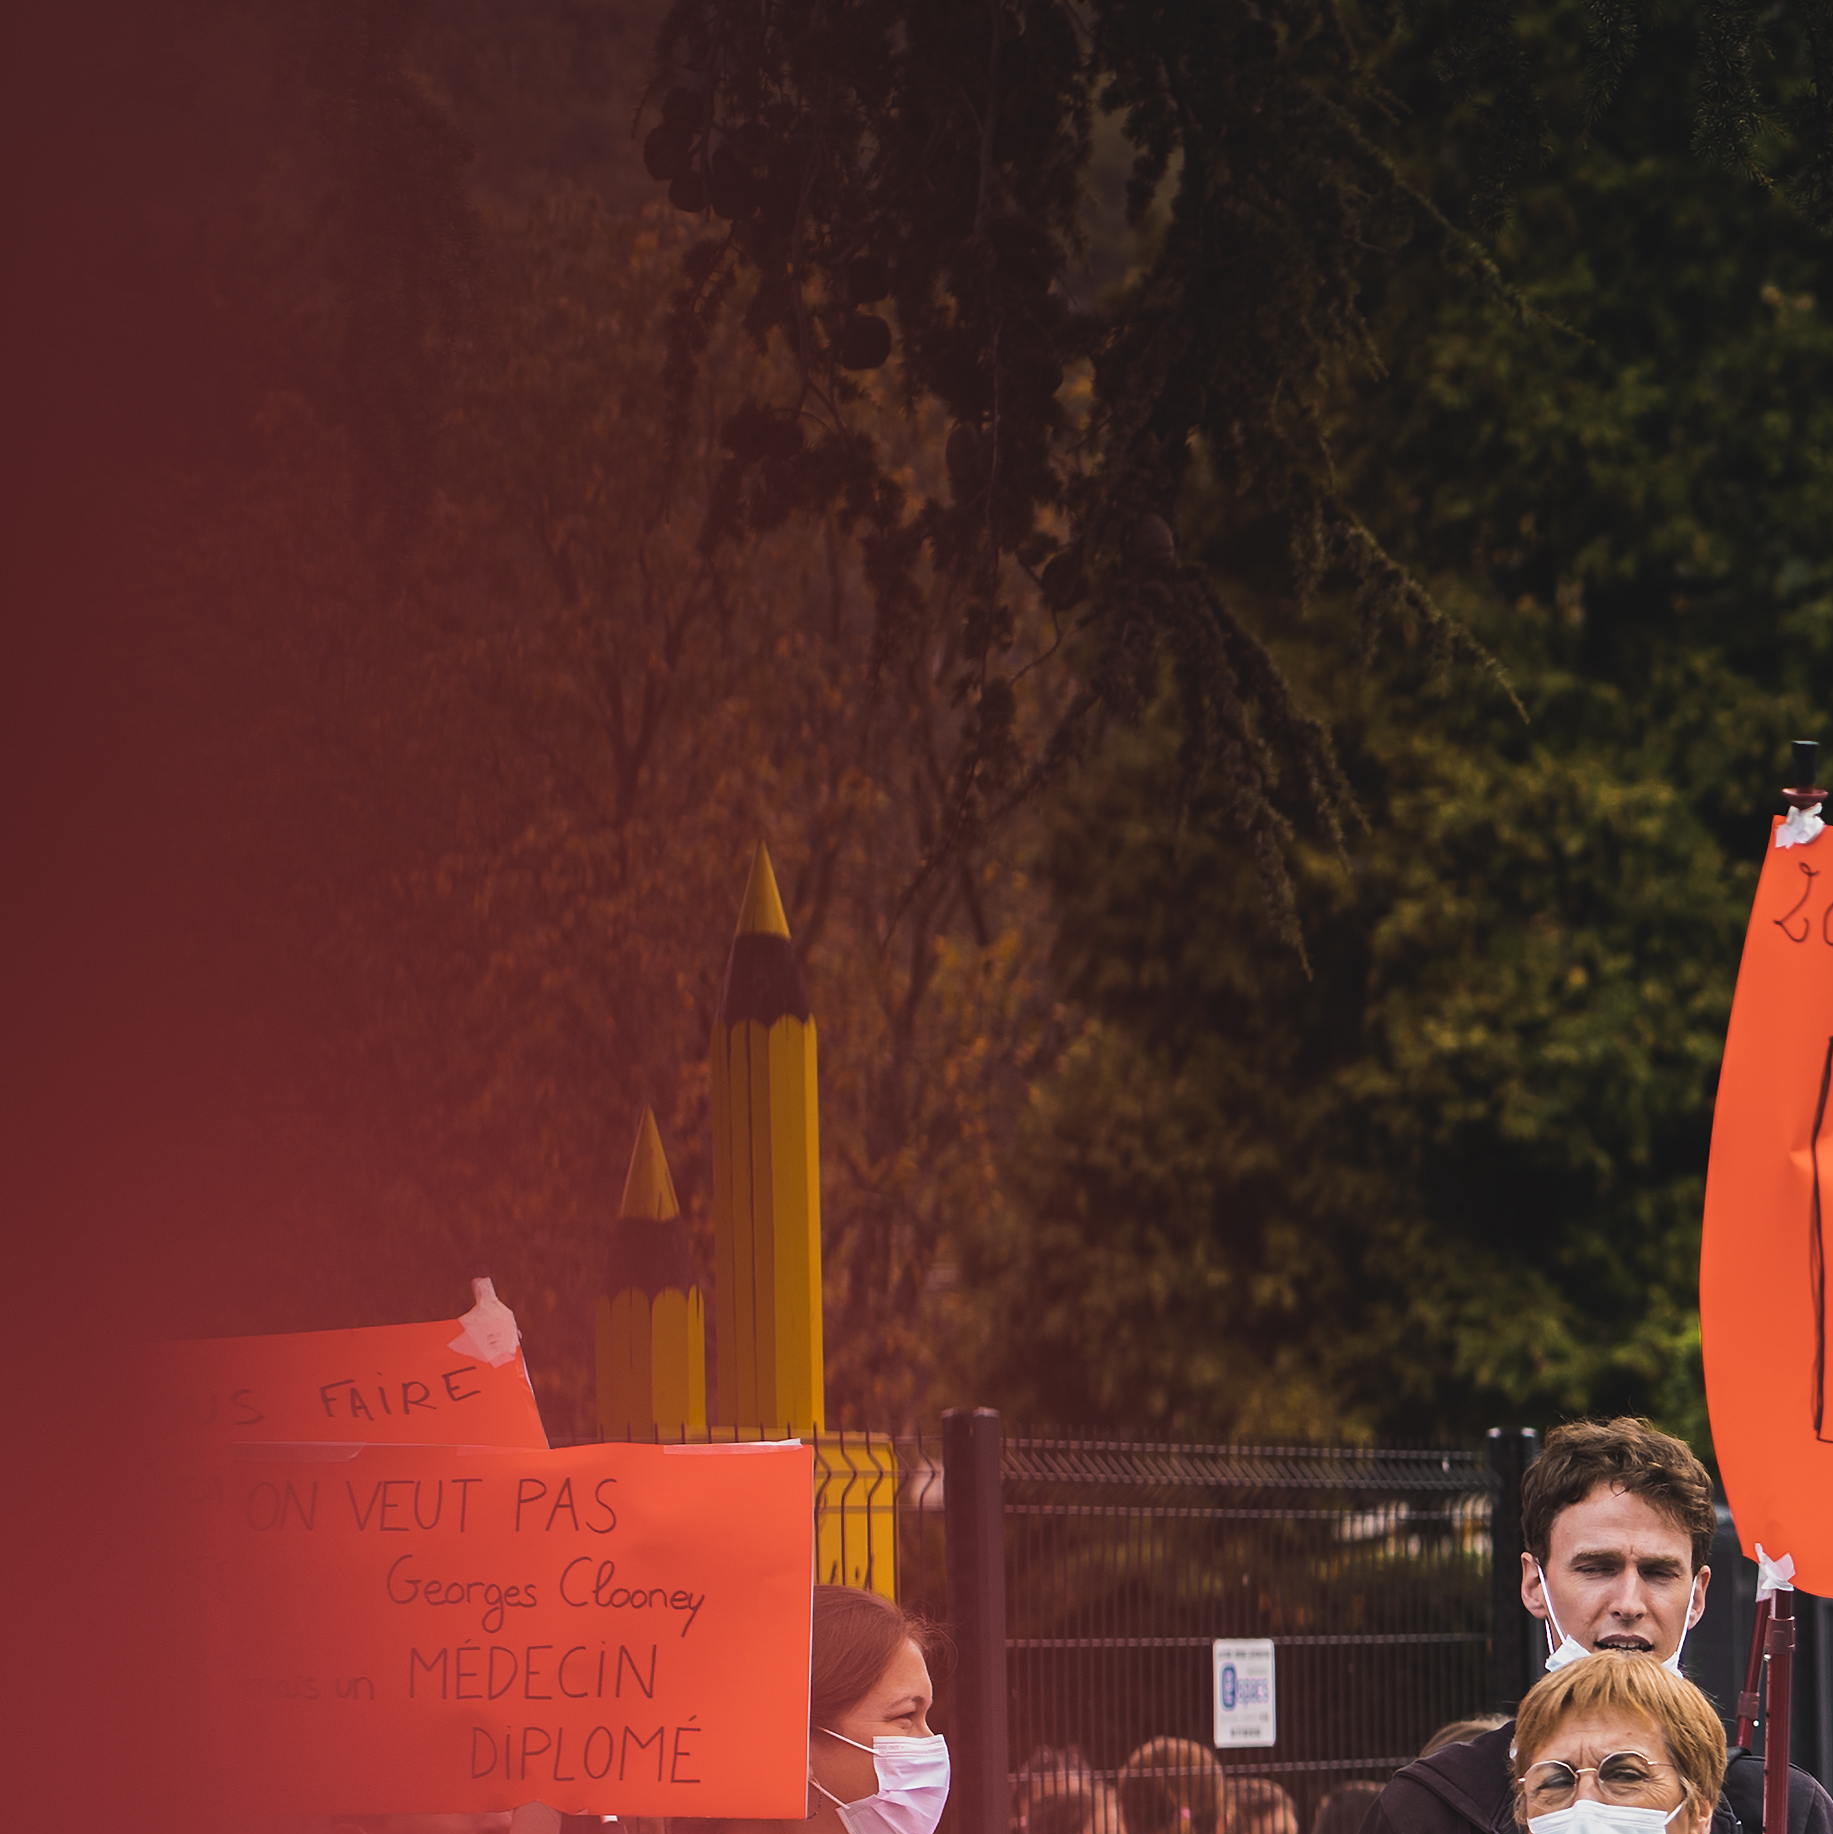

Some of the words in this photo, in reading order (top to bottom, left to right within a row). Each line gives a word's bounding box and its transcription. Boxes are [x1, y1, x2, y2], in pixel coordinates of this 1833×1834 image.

[345, 1478, 485, 1533] VEUT
[515, 1477, 620, 1534] PAS
[387, 1555, 539, 1633] Georges
[560, 1556, 705, 1638] Clooney
[334, 1676, 374, 1701] un
